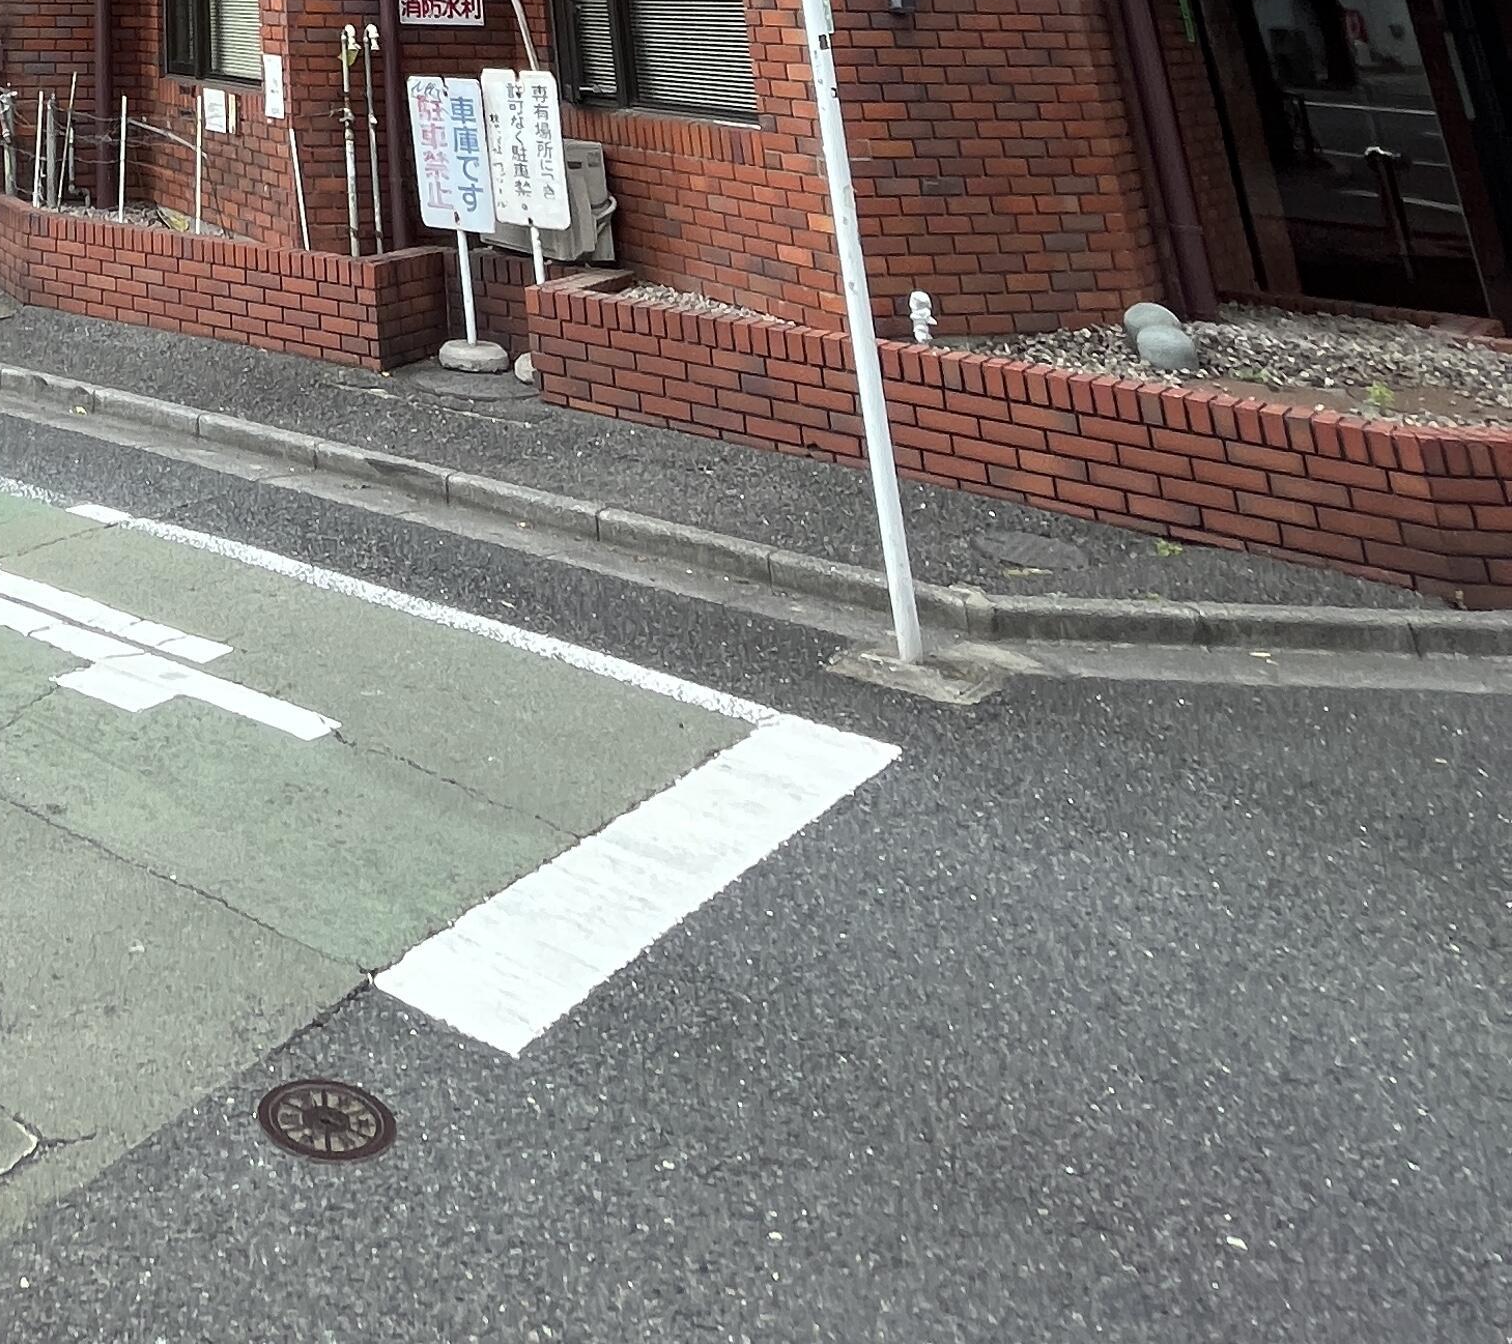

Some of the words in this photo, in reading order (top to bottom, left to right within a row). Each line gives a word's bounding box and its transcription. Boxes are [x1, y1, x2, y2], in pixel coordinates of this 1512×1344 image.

[416, 95, 454, 209] 駐車禁止
[450, 96, 484, 212] 車庫です
